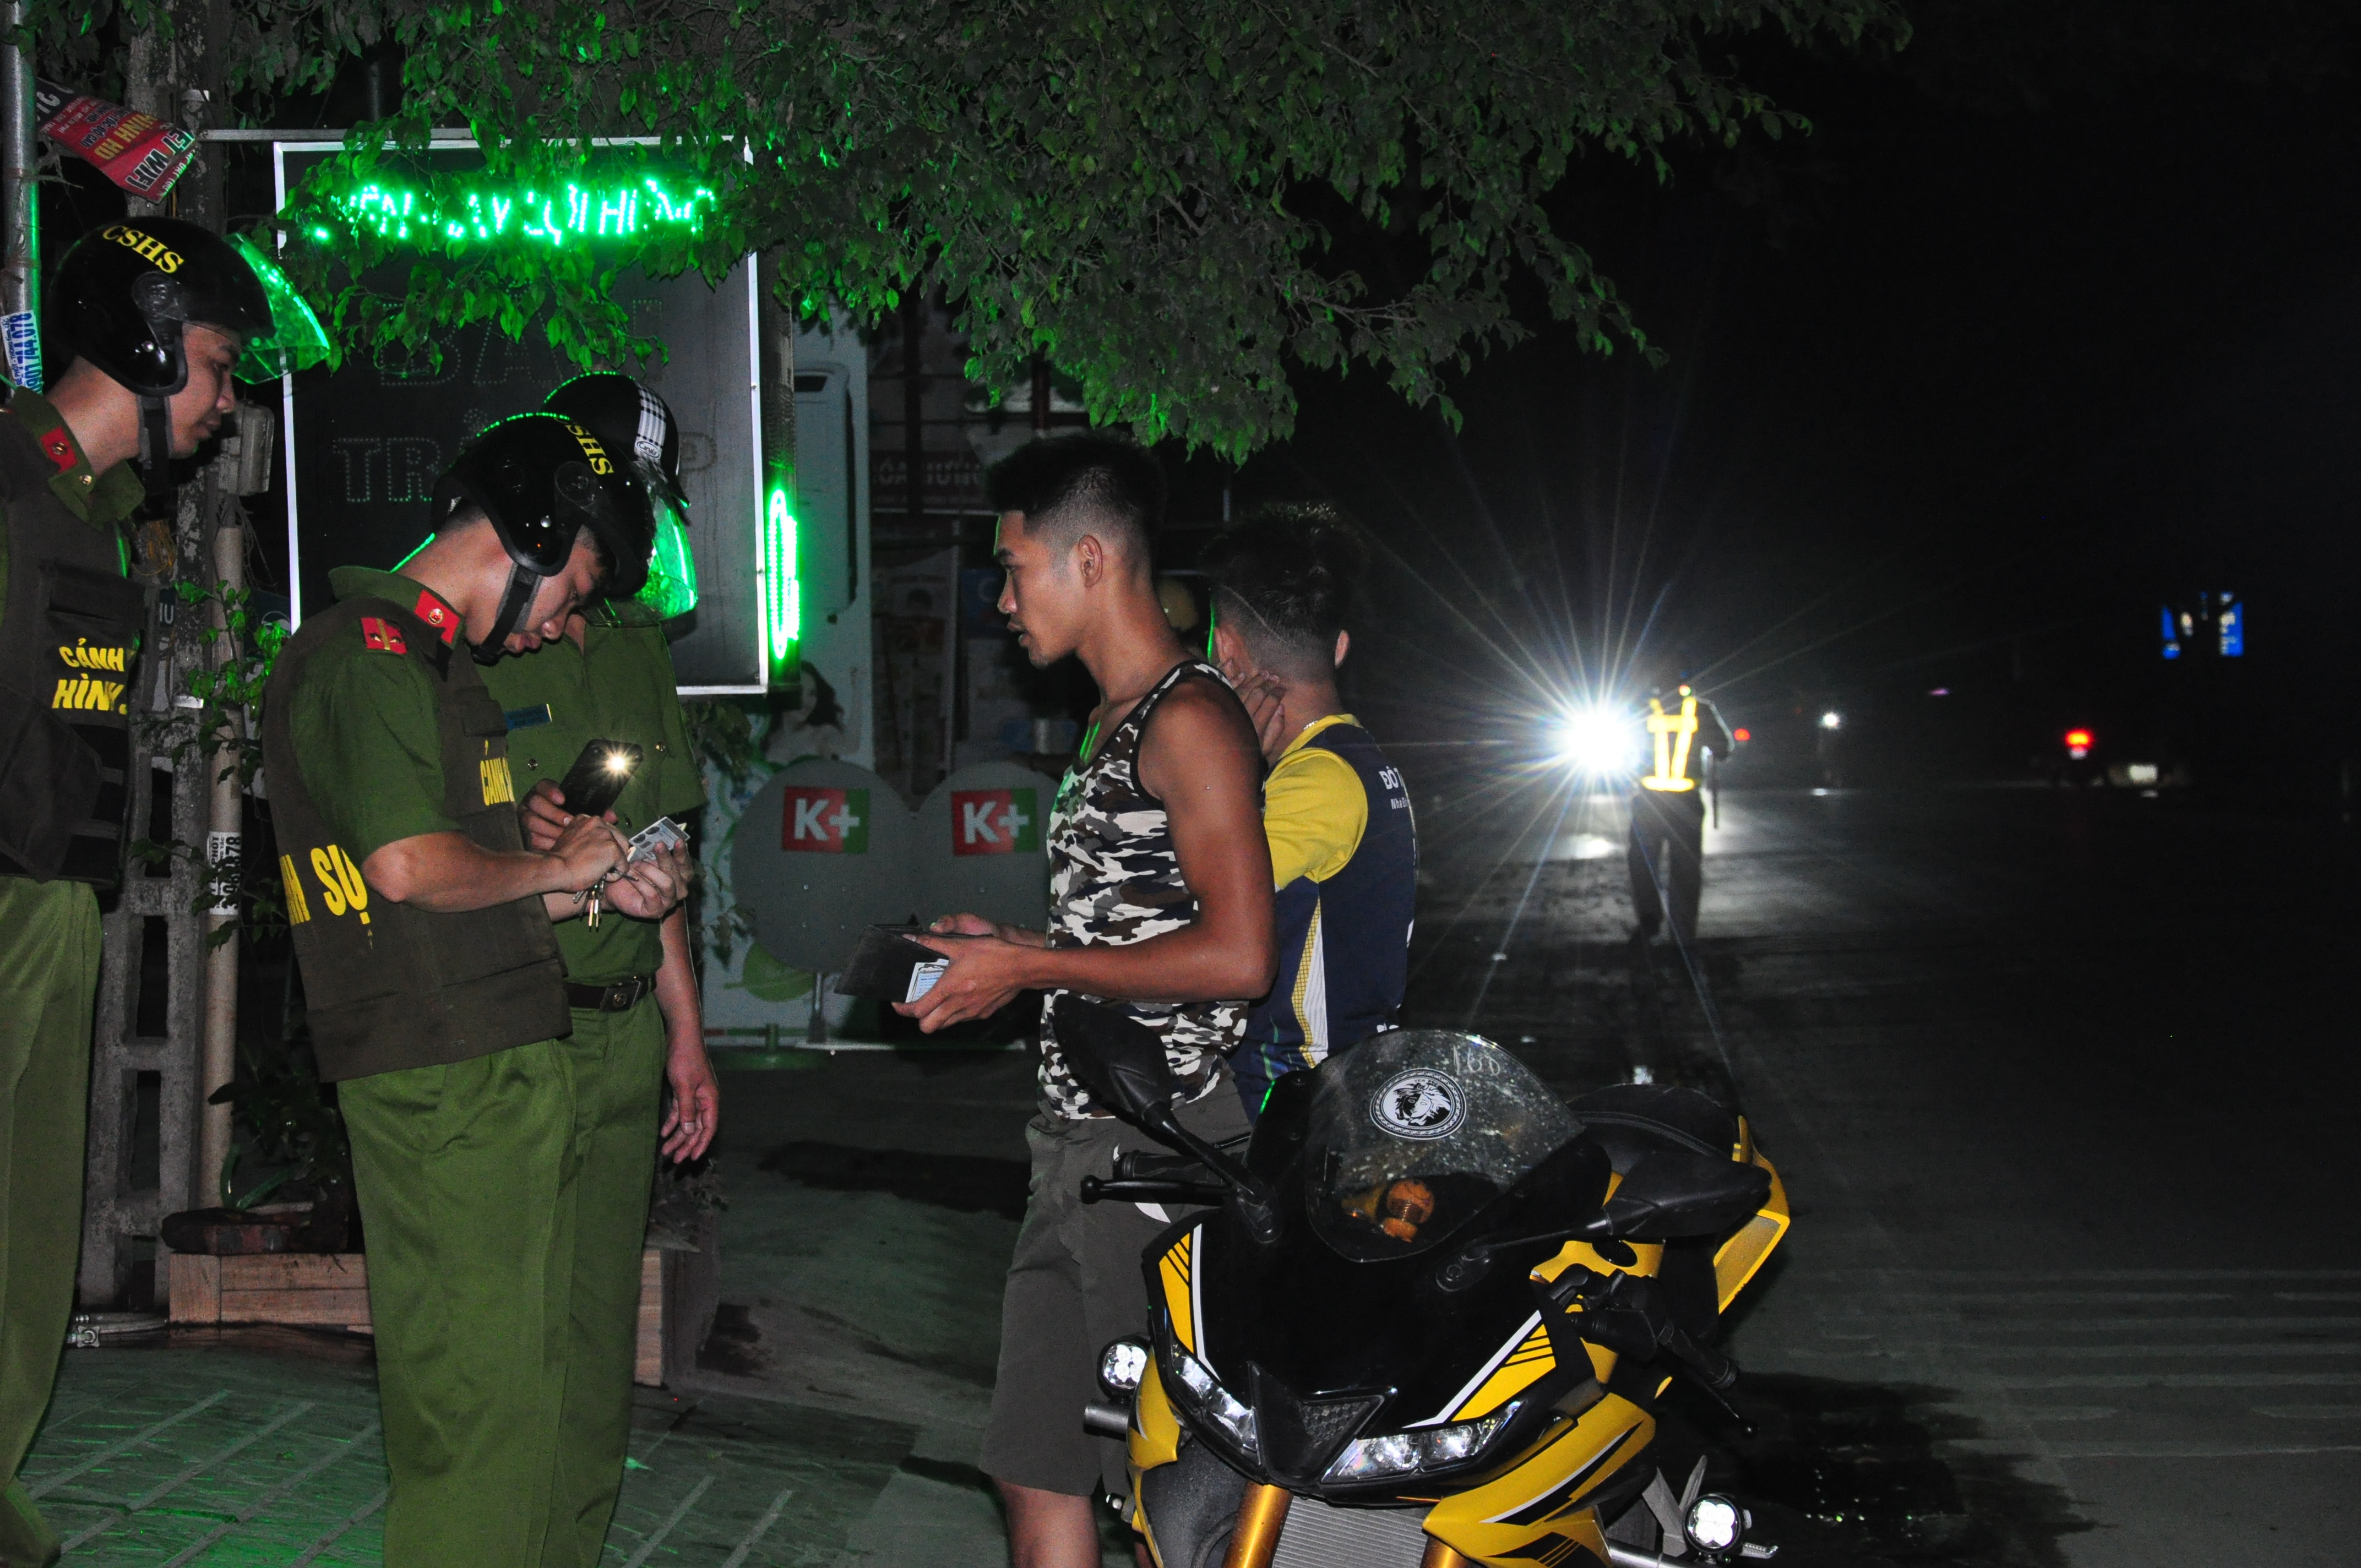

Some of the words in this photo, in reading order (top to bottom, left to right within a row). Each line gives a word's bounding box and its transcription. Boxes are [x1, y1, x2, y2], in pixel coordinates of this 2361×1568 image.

[94, 138, 124, 160] HD
[126, 148, 169, 191] WIFI
[102, 226, 184, 273] CSHS
[59, 638, 124, 672] CẢNH
[794, 797, 861, 841] K+
[963, 801, 1030, 844] K+
